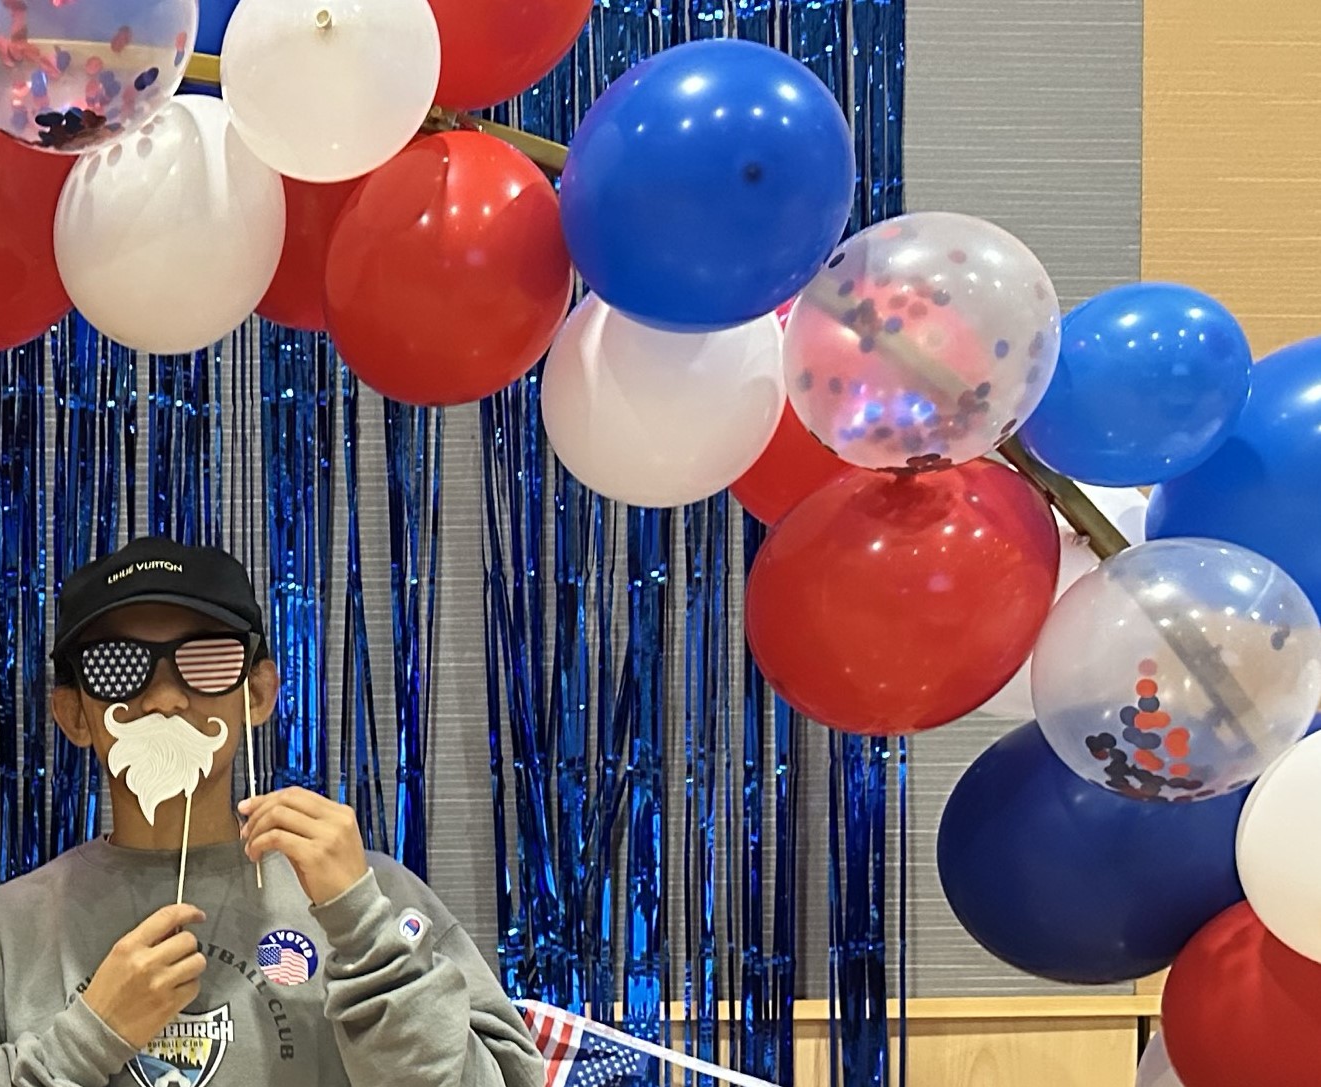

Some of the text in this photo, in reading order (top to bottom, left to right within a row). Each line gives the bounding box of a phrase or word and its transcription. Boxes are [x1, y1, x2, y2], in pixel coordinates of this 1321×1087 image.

[136, 560, 183, 573] VUITTON
[268, 931, 313, 958] I VOTED
[268, 998, 294, 1060] CLUB
